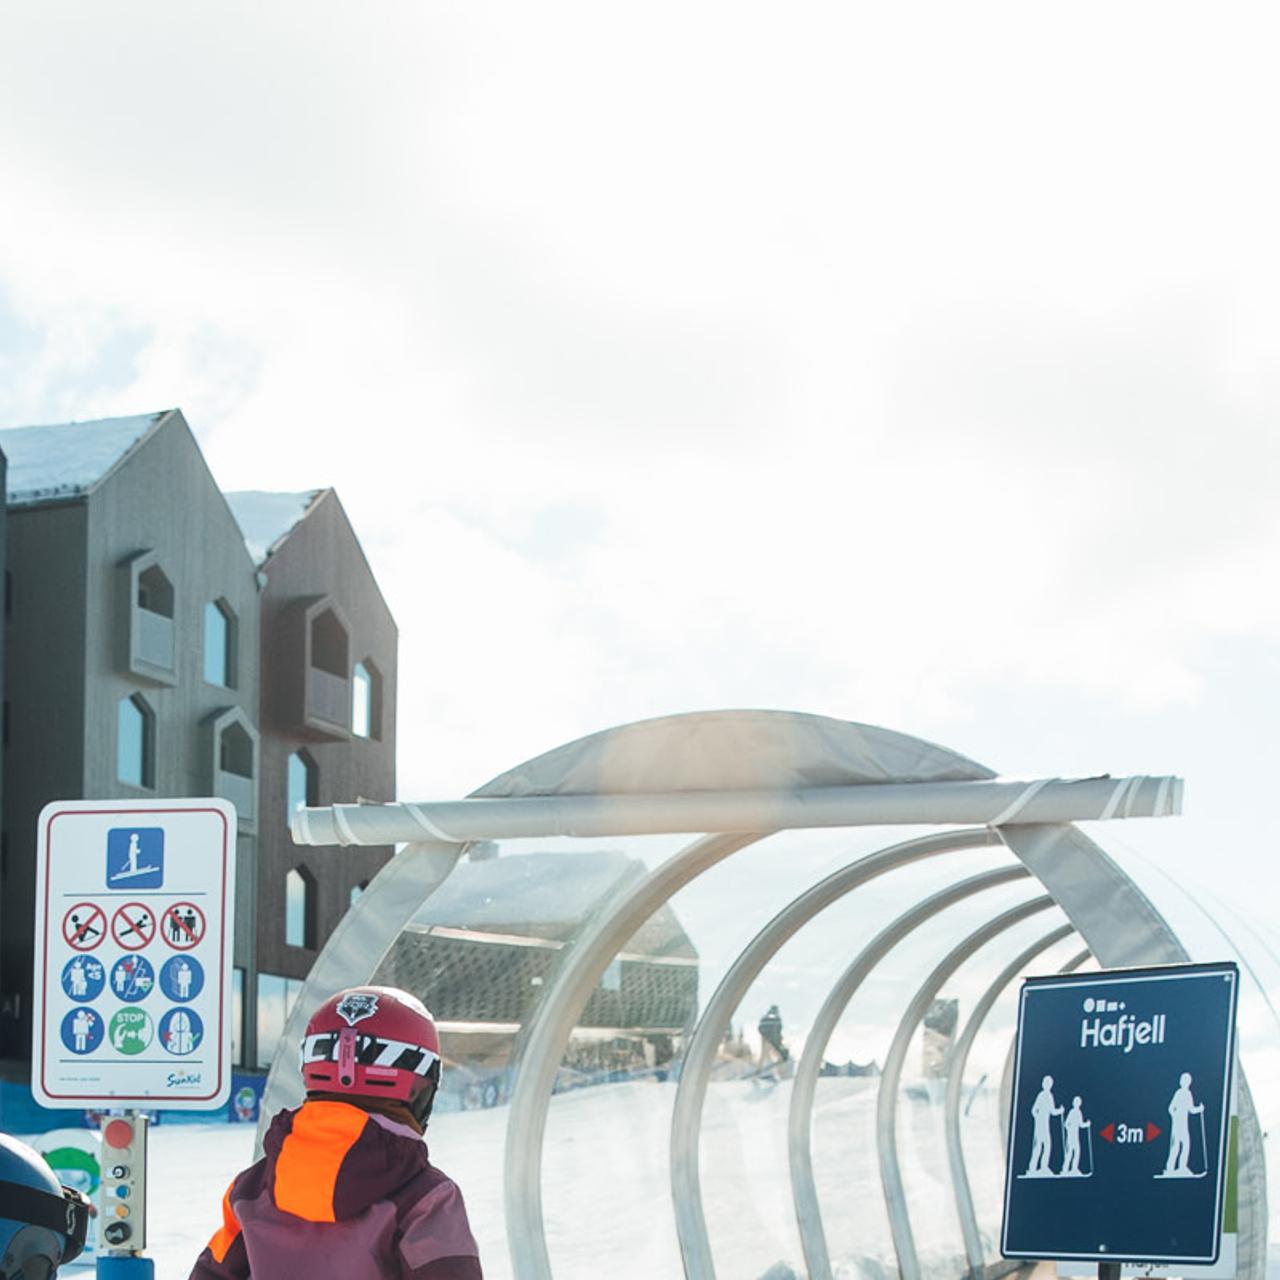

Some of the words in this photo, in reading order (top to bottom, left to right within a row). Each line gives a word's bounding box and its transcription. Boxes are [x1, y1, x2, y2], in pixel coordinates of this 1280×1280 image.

[117, 1012, 145, 1024] STOP
[1081, 1014, 1166, 1053] Hafjell
[1116, 1123, 1144, 1143] 3m
